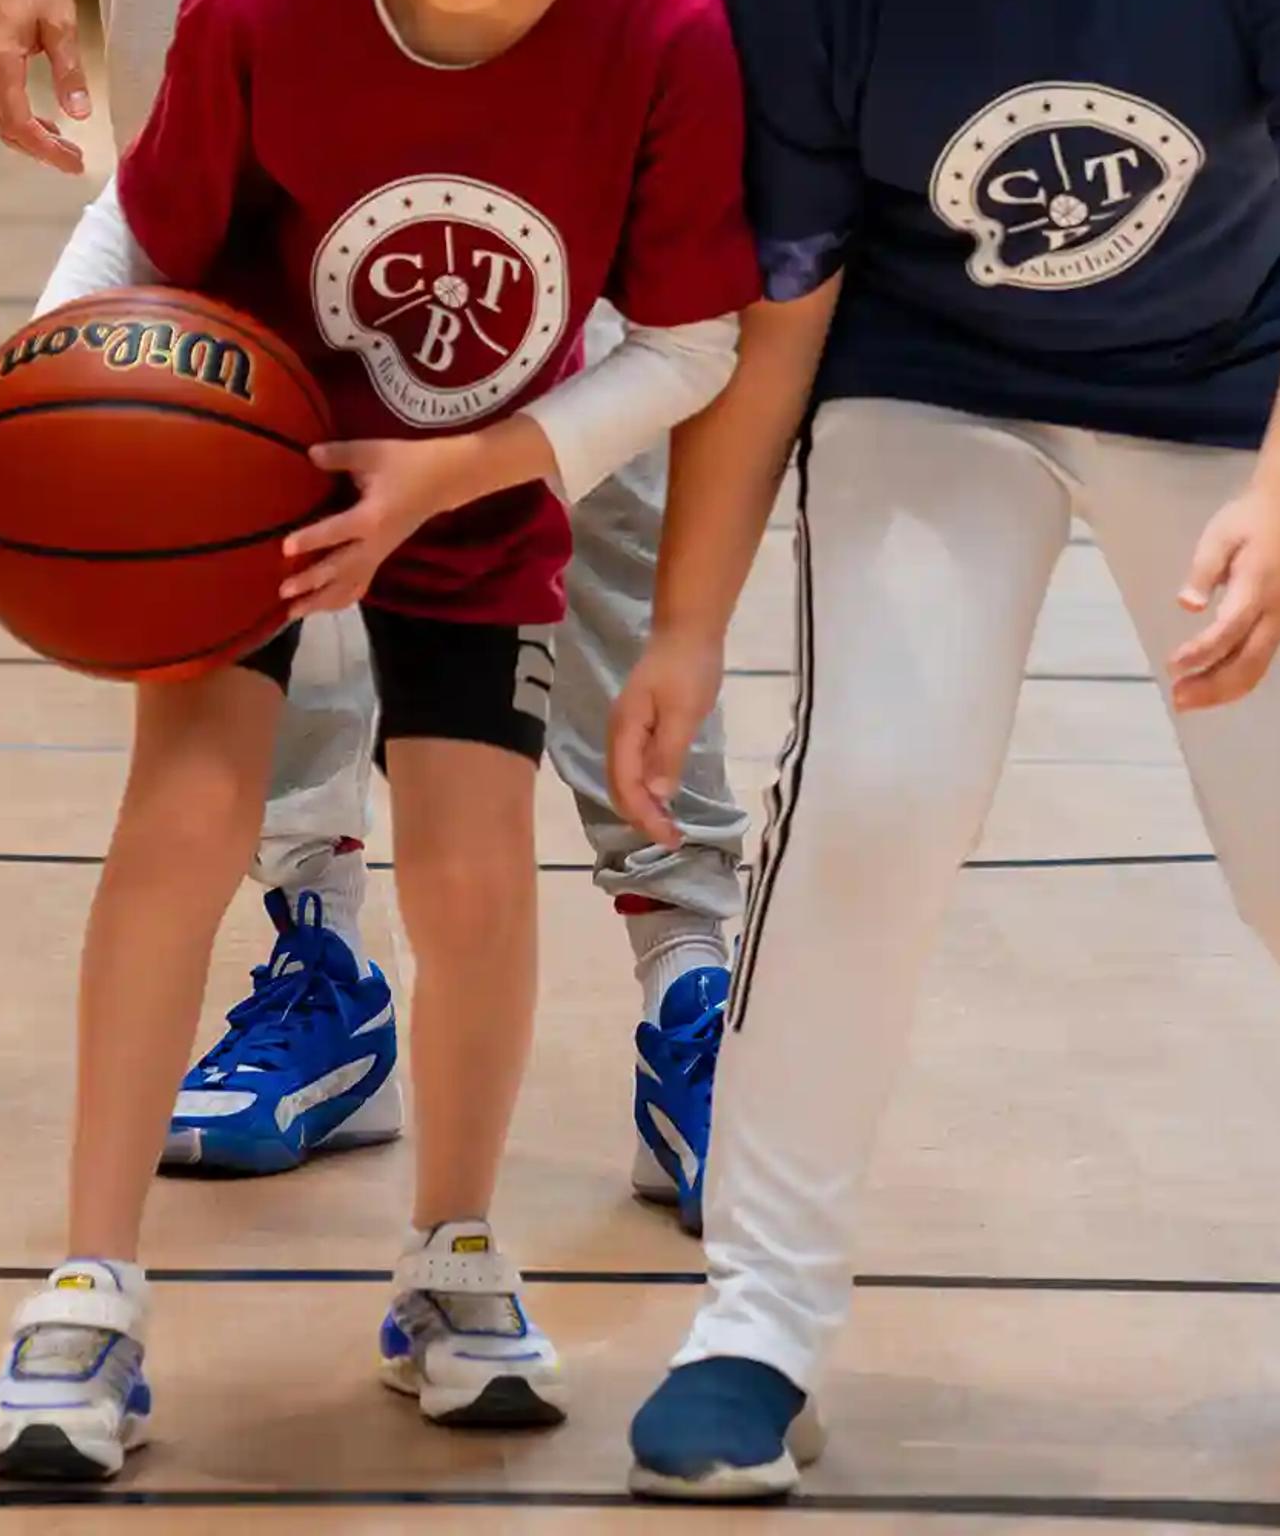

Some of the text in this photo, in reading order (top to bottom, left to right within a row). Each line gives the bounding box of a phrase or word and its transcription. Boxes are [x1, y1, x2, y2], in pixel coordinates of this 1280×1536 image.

[987, 148, 1139, 206] C T
[369, 250, 521, 313] C T
[0, 321, 255, 404] Wilson
[413, 303, 461, 371] B
